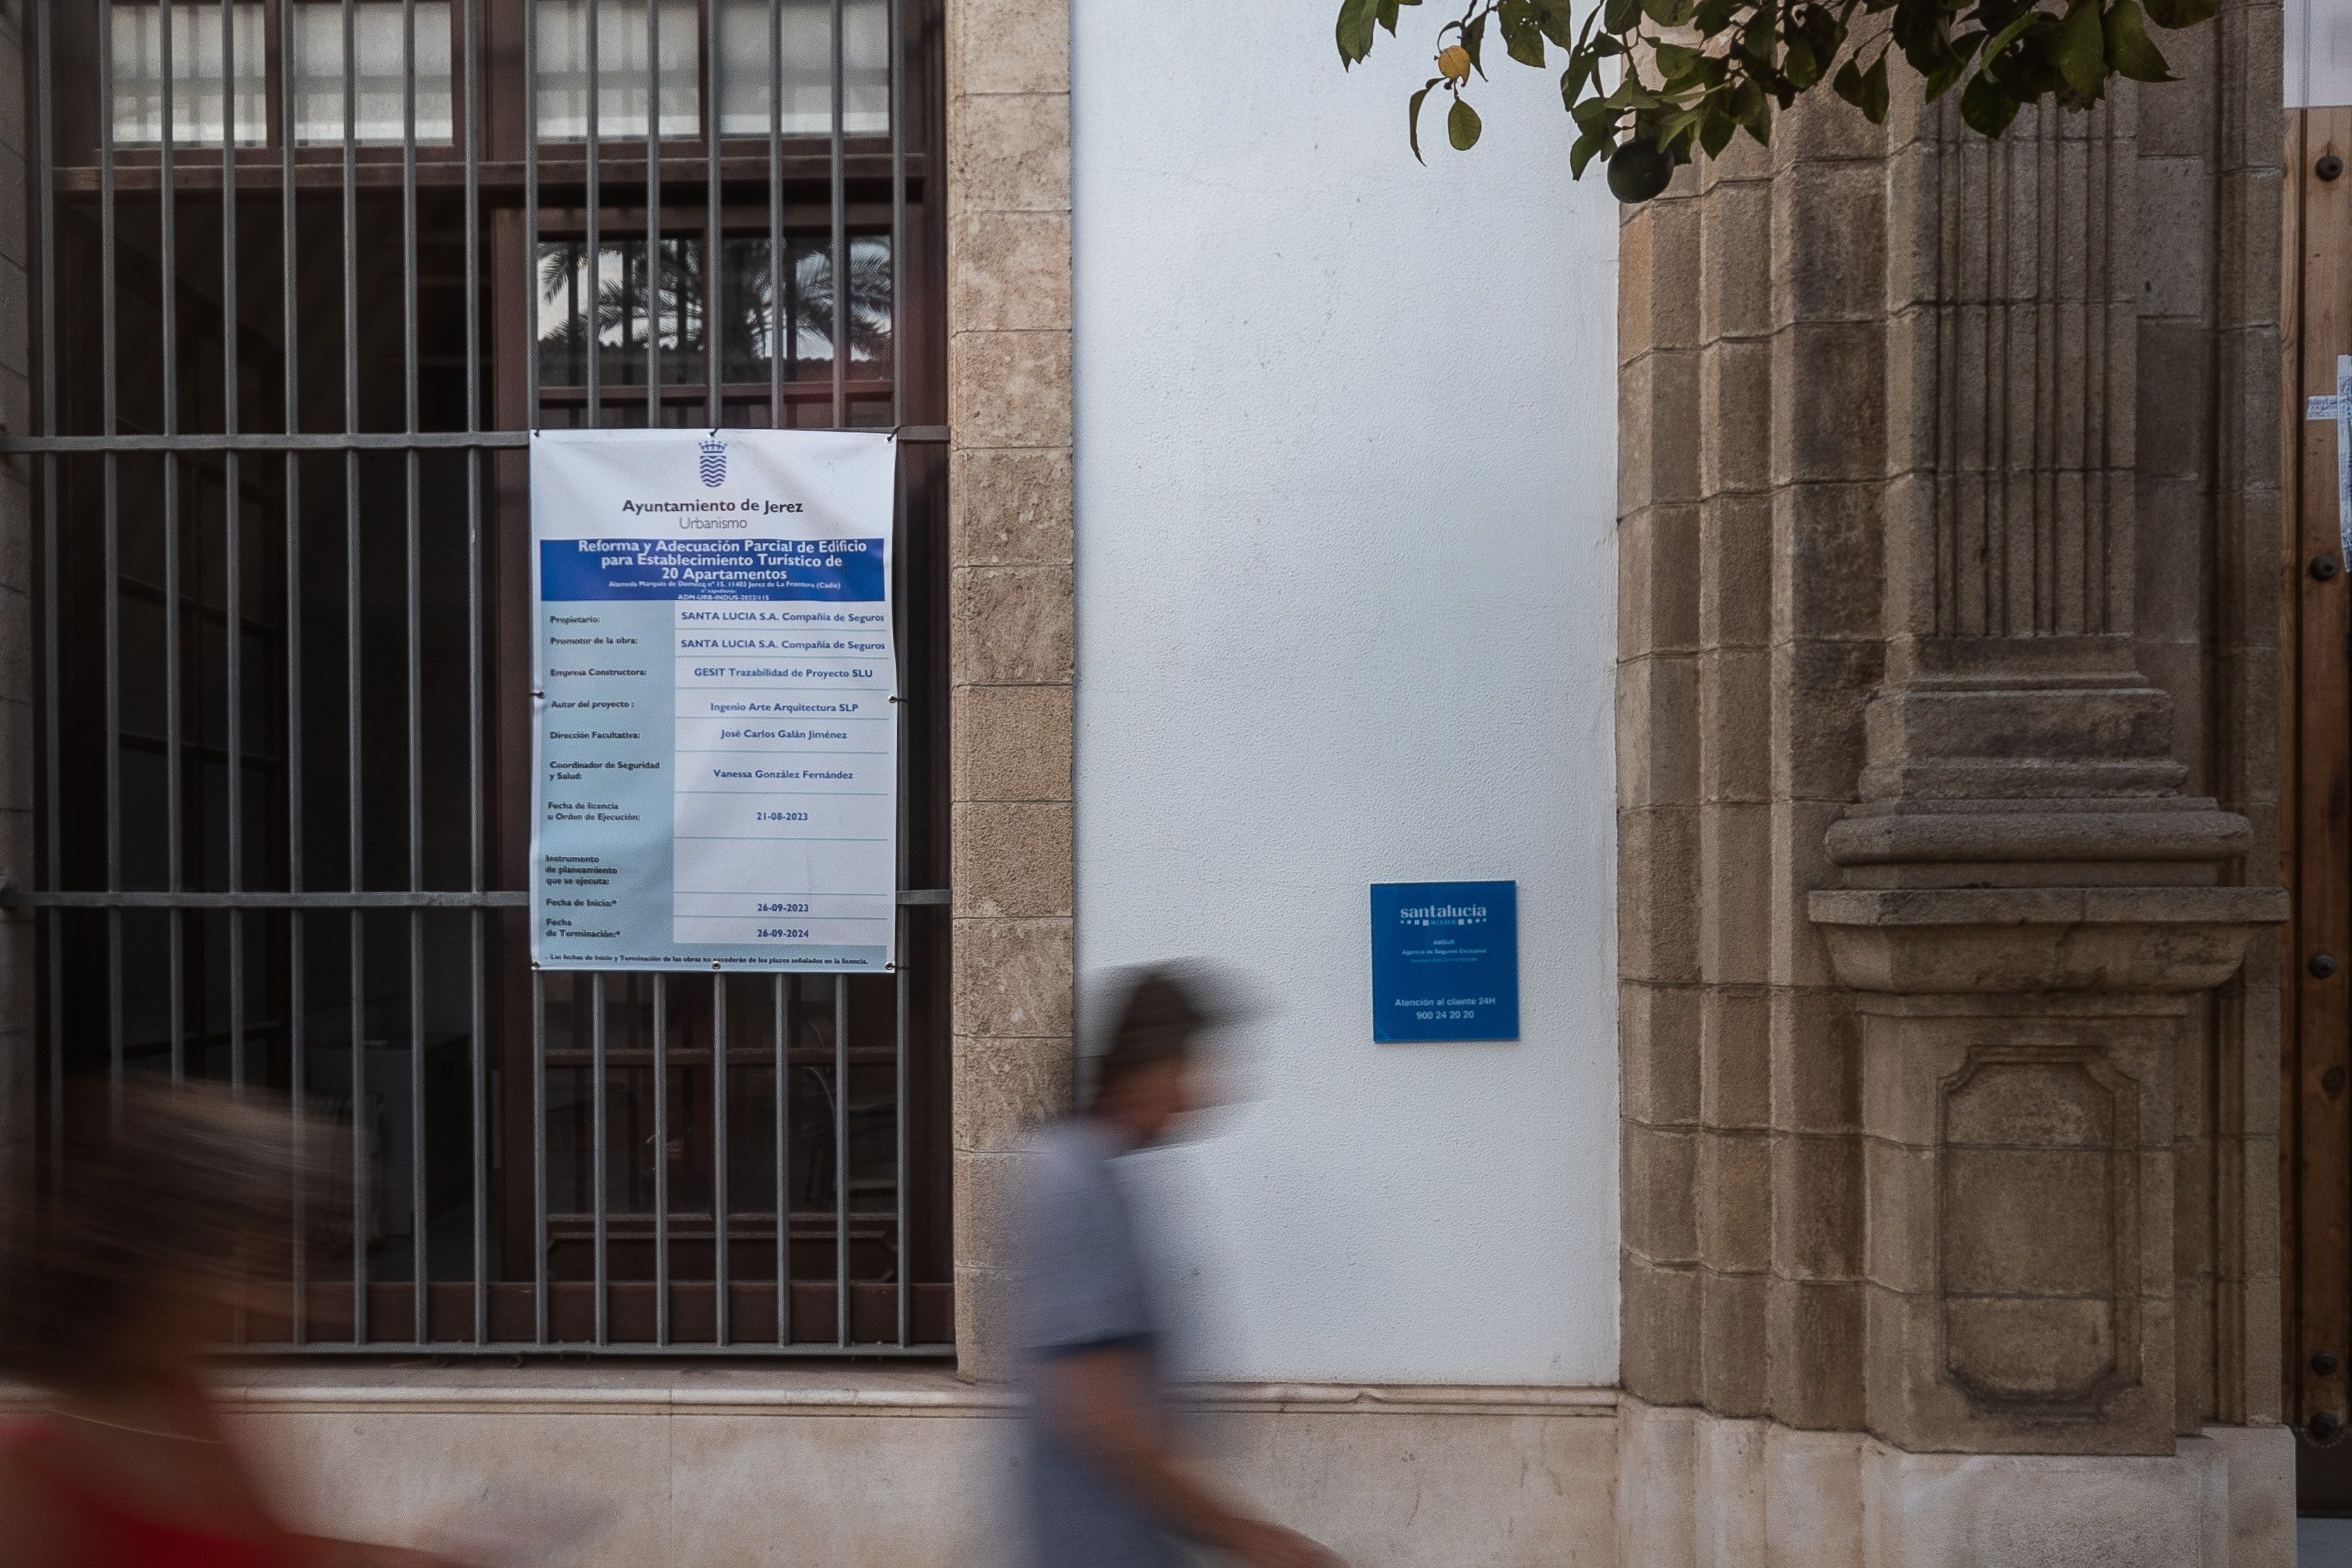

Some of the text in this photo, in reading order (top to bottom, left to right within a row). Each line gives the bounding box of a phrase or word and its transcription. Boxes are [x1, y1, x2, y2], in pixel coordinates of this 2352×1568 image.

[623, 498, 803, 515] Ayuntamiento de Jerez
[679, 517, 748, 529] Urbanismo
[578, 539, 867, 555] Reforma y Adecuación Parcial de Edificio
[601, 553, 843, 570] para Establecimiento Turístico de
[661, 567, 787, 583] 20 Apartamentos
[550, 615, 600, 625] Propietario:
[682, 612, 884, 624] SANTA LUCIA S.A. Compañía de Seguros
[681, 639, 885, 651] SANTA LUCIA S.A. Compañía de Seguros
[550, 668, 647, 677] Empresa Constructora:
[694, 668, 726, 677] GESIT
[729, 668, 789, 677] Trazabilidad
[792, 669, 803, 677] de
[806, 670, 849, 680] Proyecto
[592, 701, 630, 710] proyecto
[711, 703, 858, 713] Ingenio Arte Arquitectura SLP
[550, 731, 640, 739] Dirección Facultativa:
[721, 729, 848, 740] José Carlos Galán Jiménez
[618, 761, 660, 770] Seguridad
[713, 768, 853, 780] Vanessa González Fernández
[548, 801, 573, 810] Fecha
[587, 801, 619, 810] licencia
[597, 813, 640, 822] Ejecución:
[756, 812, 808, 820] 21-08-2023
[545, 855, 599, 863] Instrumento
[558, 866, 618, 875] planeamiento
[574, 898, 584, 907] de
[757, 903, 809, 912] 26-09-2023
[757, 929, 809, 938] 26-09-2024
[769, 957, 790, 965] plazos
[1395, 998, 1434, 1007] Atención
[1437, 998, 1444, 1006] al
[1416, 1011, 1434, 1020] 900
[1450, 1010, 1461, 1019] 20
[1463, 1010, 1475, 1019] 20
